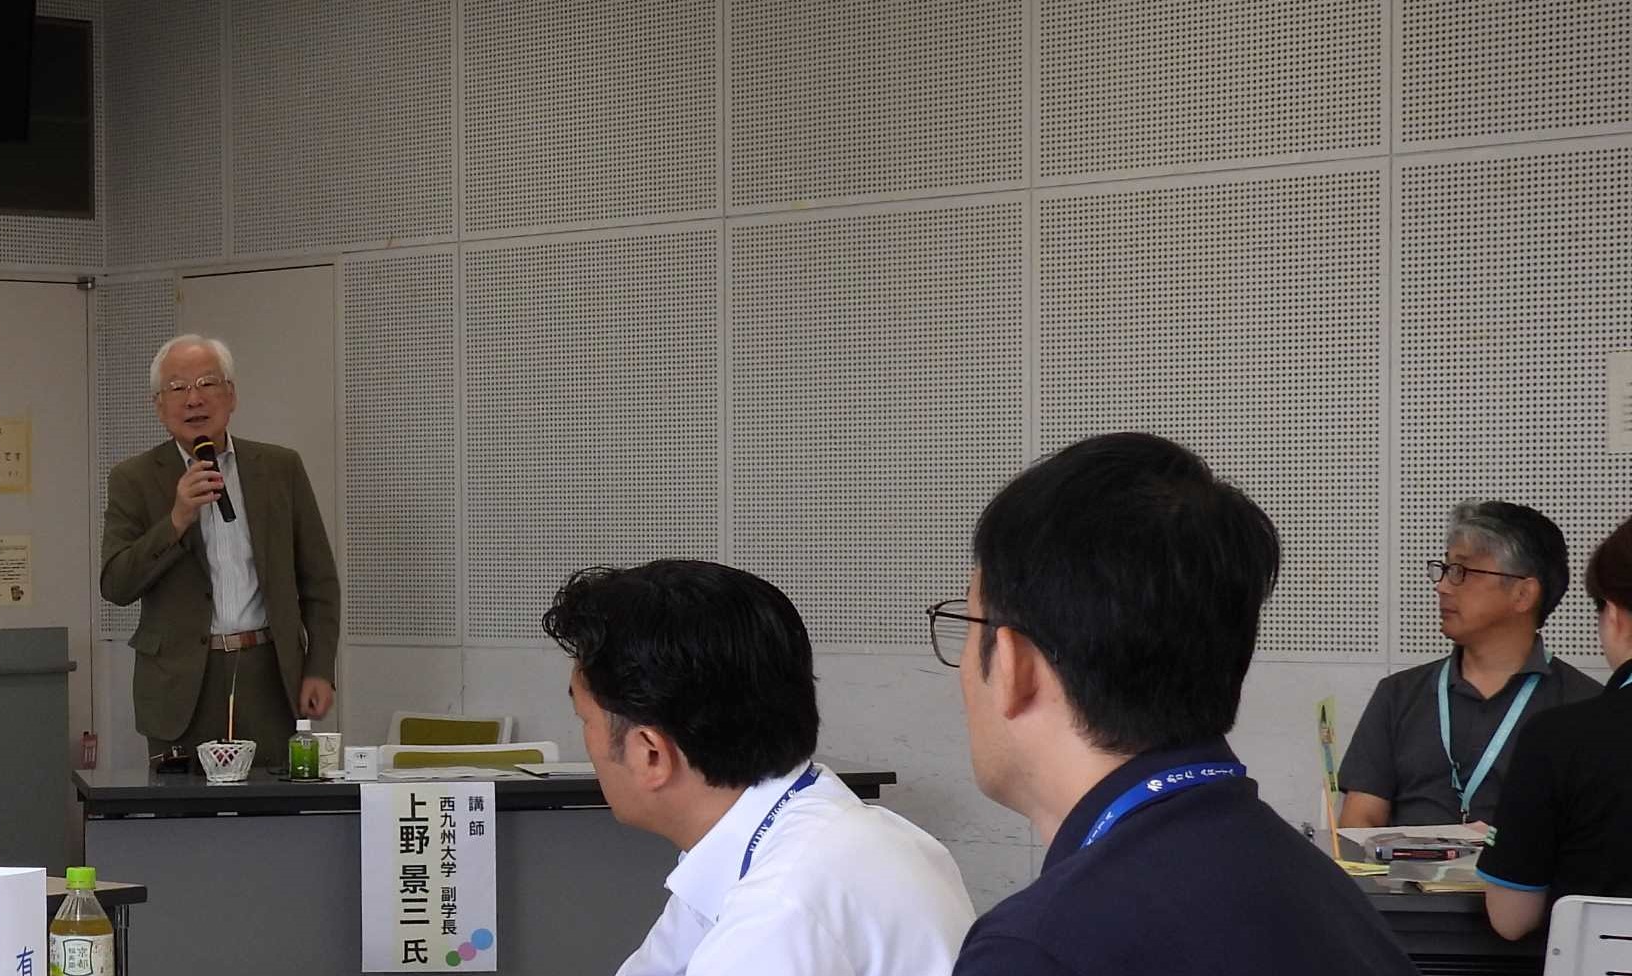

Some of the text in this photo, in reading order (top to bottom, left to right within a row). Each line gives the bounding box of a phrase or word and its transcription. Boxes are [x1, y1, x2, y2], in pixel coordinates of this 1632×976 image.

[398, 792, 431, 965] 上野 景三 氏
[439, 796, 457, 936] 西九州大学 副学長
[468, 795, 485, 837] 講師
